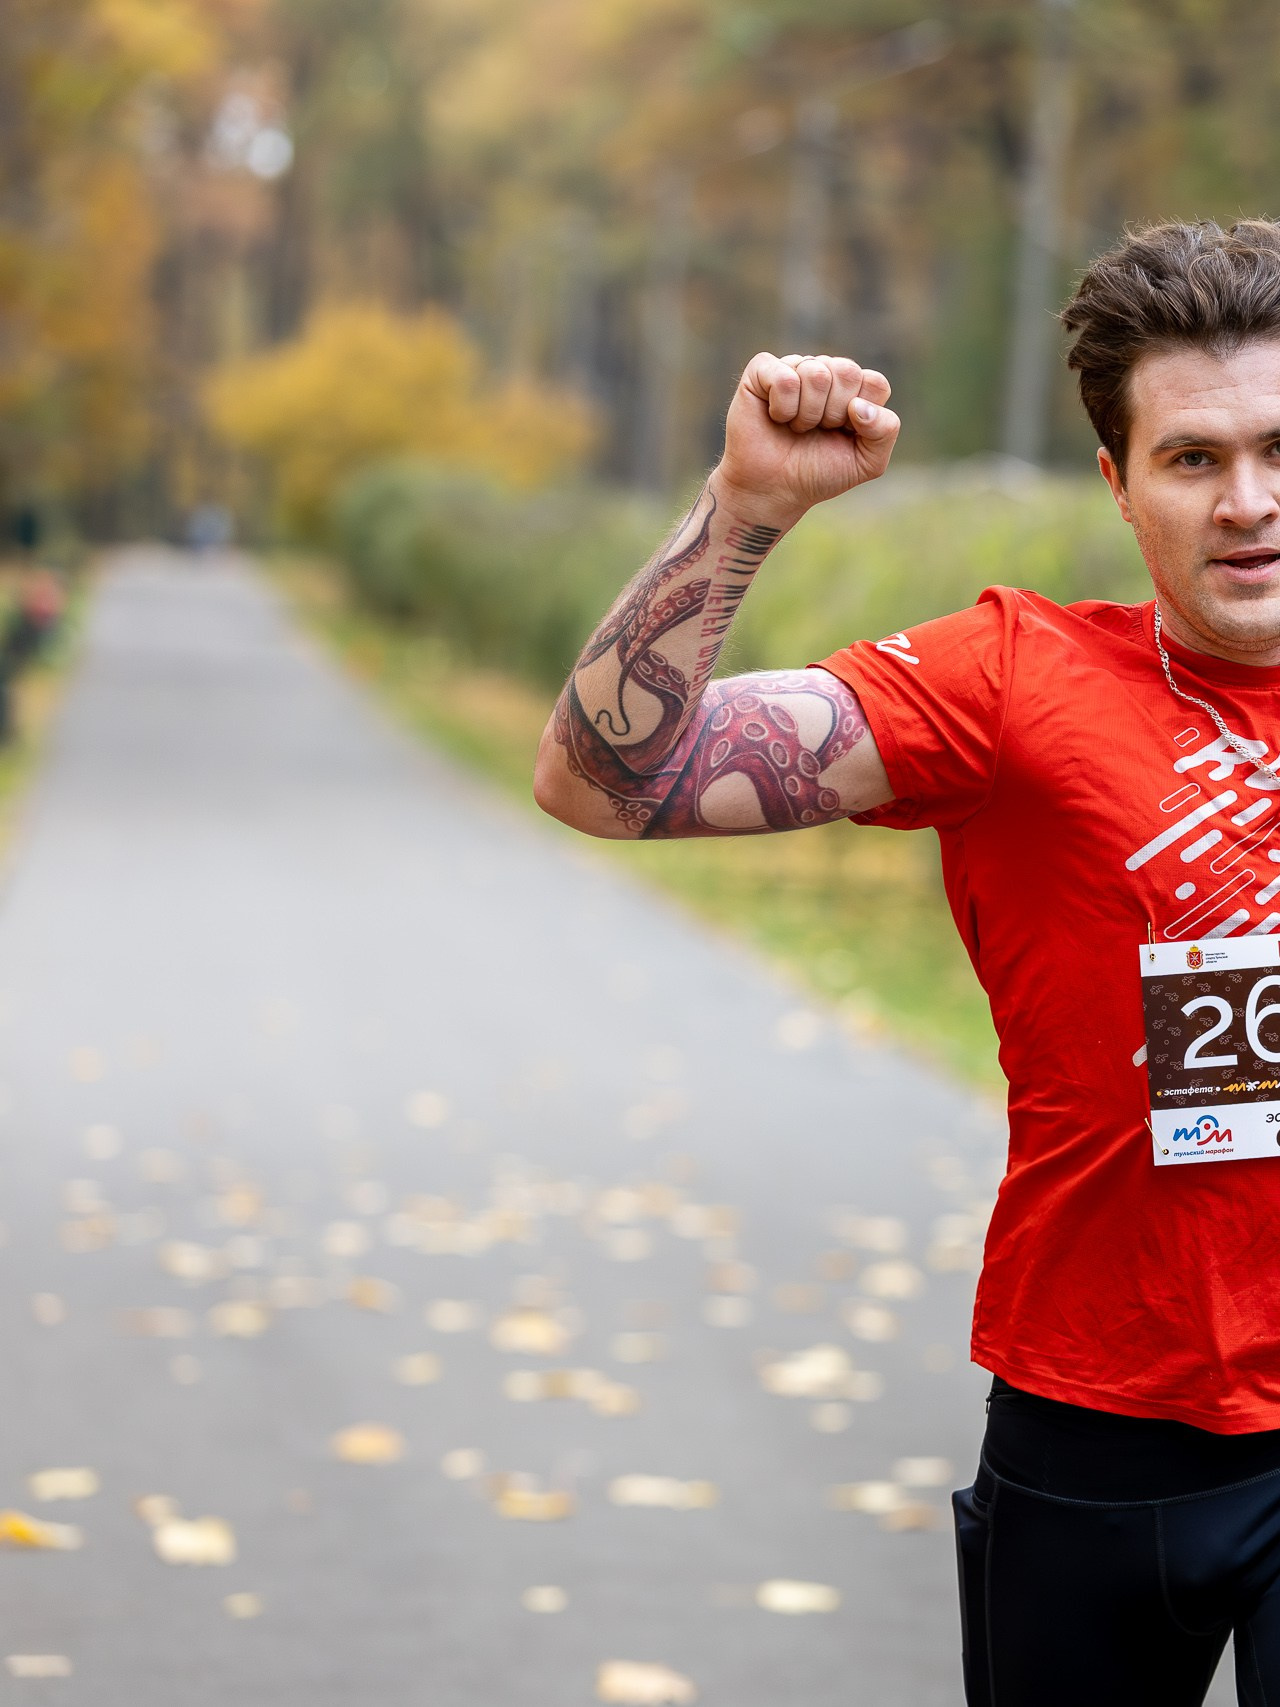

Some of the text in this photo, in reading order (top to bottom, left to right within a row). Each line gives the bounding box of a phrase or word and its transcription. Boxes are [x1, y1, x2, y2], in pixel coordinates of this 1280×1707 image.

[1163, 1085, 1214, 1096] эстафета
[1173, 1147, 1234, 1158] тульский марафон
